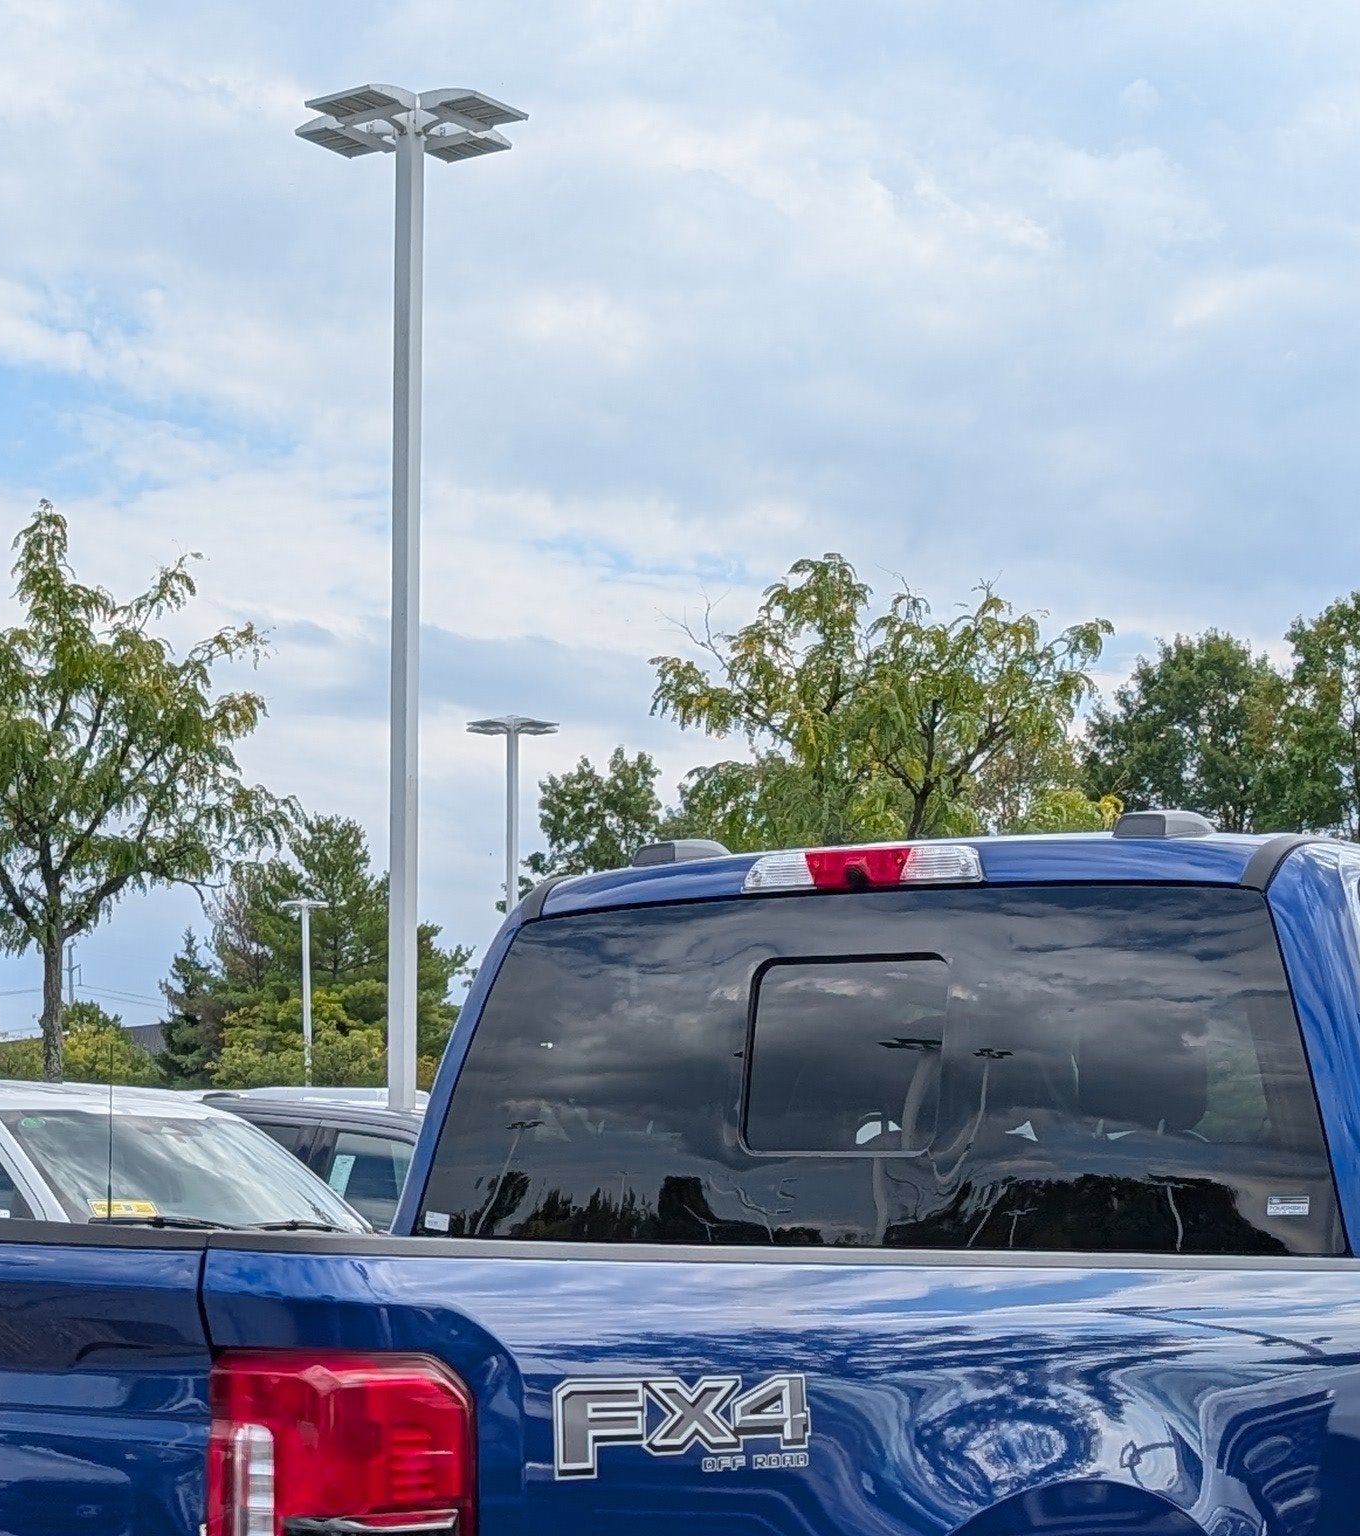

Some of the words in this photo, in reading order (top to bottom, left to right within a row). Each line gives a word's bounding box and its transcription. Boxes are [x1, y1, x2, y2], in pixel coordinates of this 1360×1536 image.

[553, 1374, 811, 1481] FX4
[702, 1455, 746, 1472] OFF
[752, 1453, 809, 1470] ROAD
